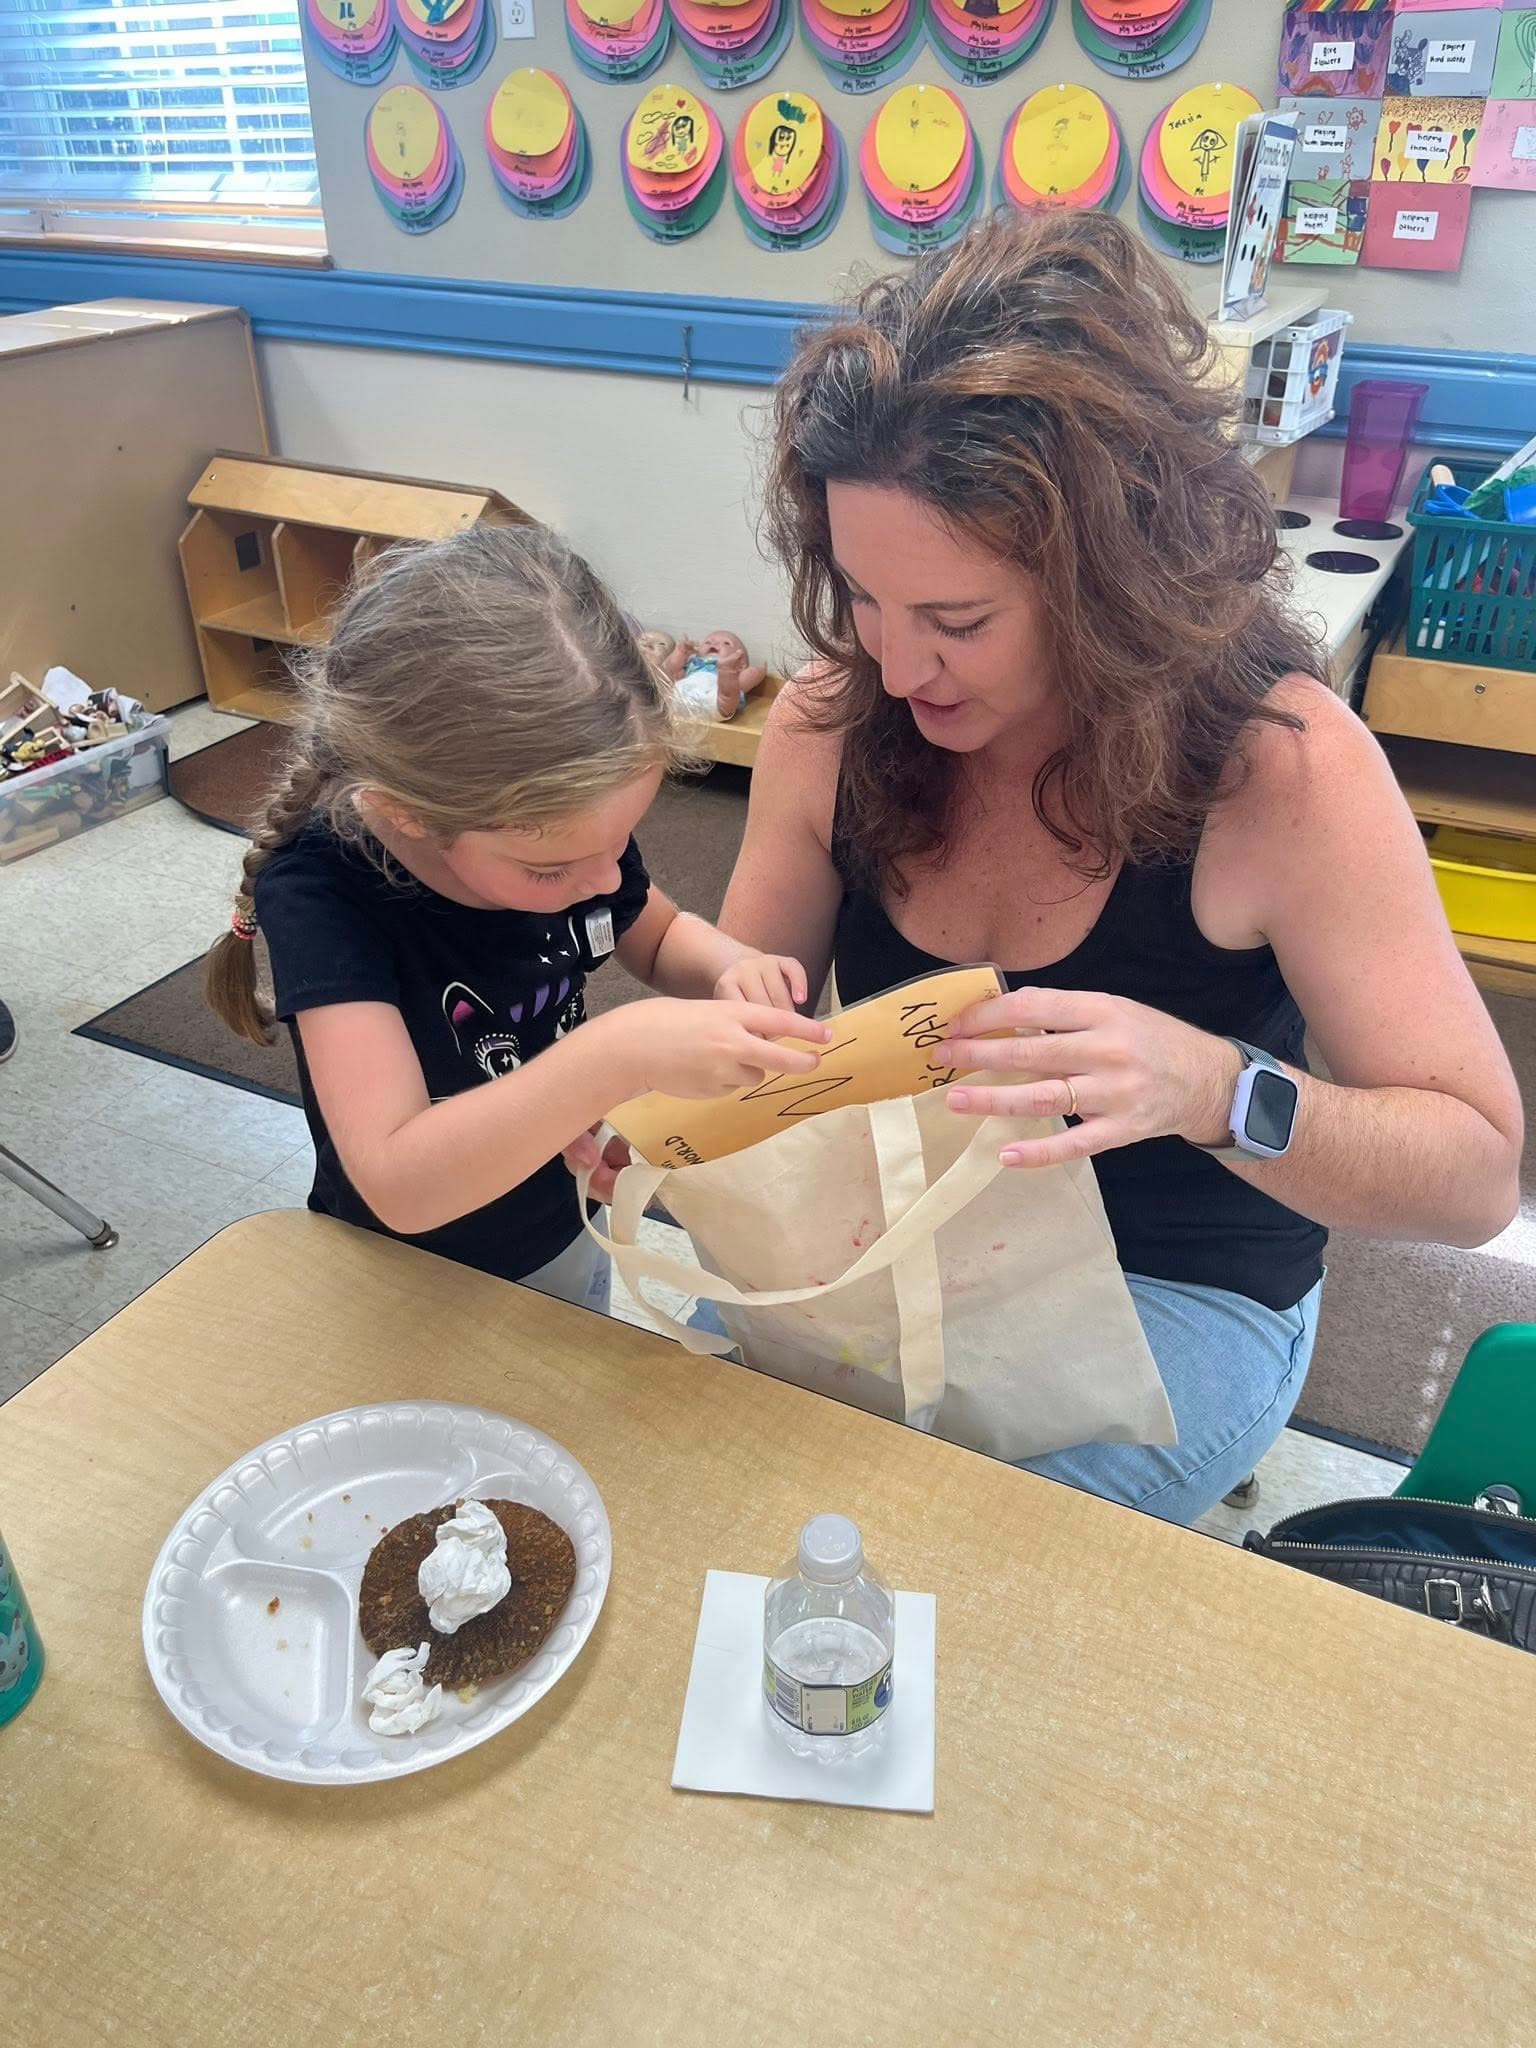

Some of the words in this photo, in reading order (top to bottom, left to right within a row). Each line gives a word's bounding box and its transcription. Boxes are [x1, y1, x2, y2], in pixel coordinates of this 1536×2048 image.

[1417, 133, 1443, 144] helping
[1410, 144, 1428, 152] them
[1429, 146, 1448, 154] clean
[900, 1001, 951, 1050] DAY
